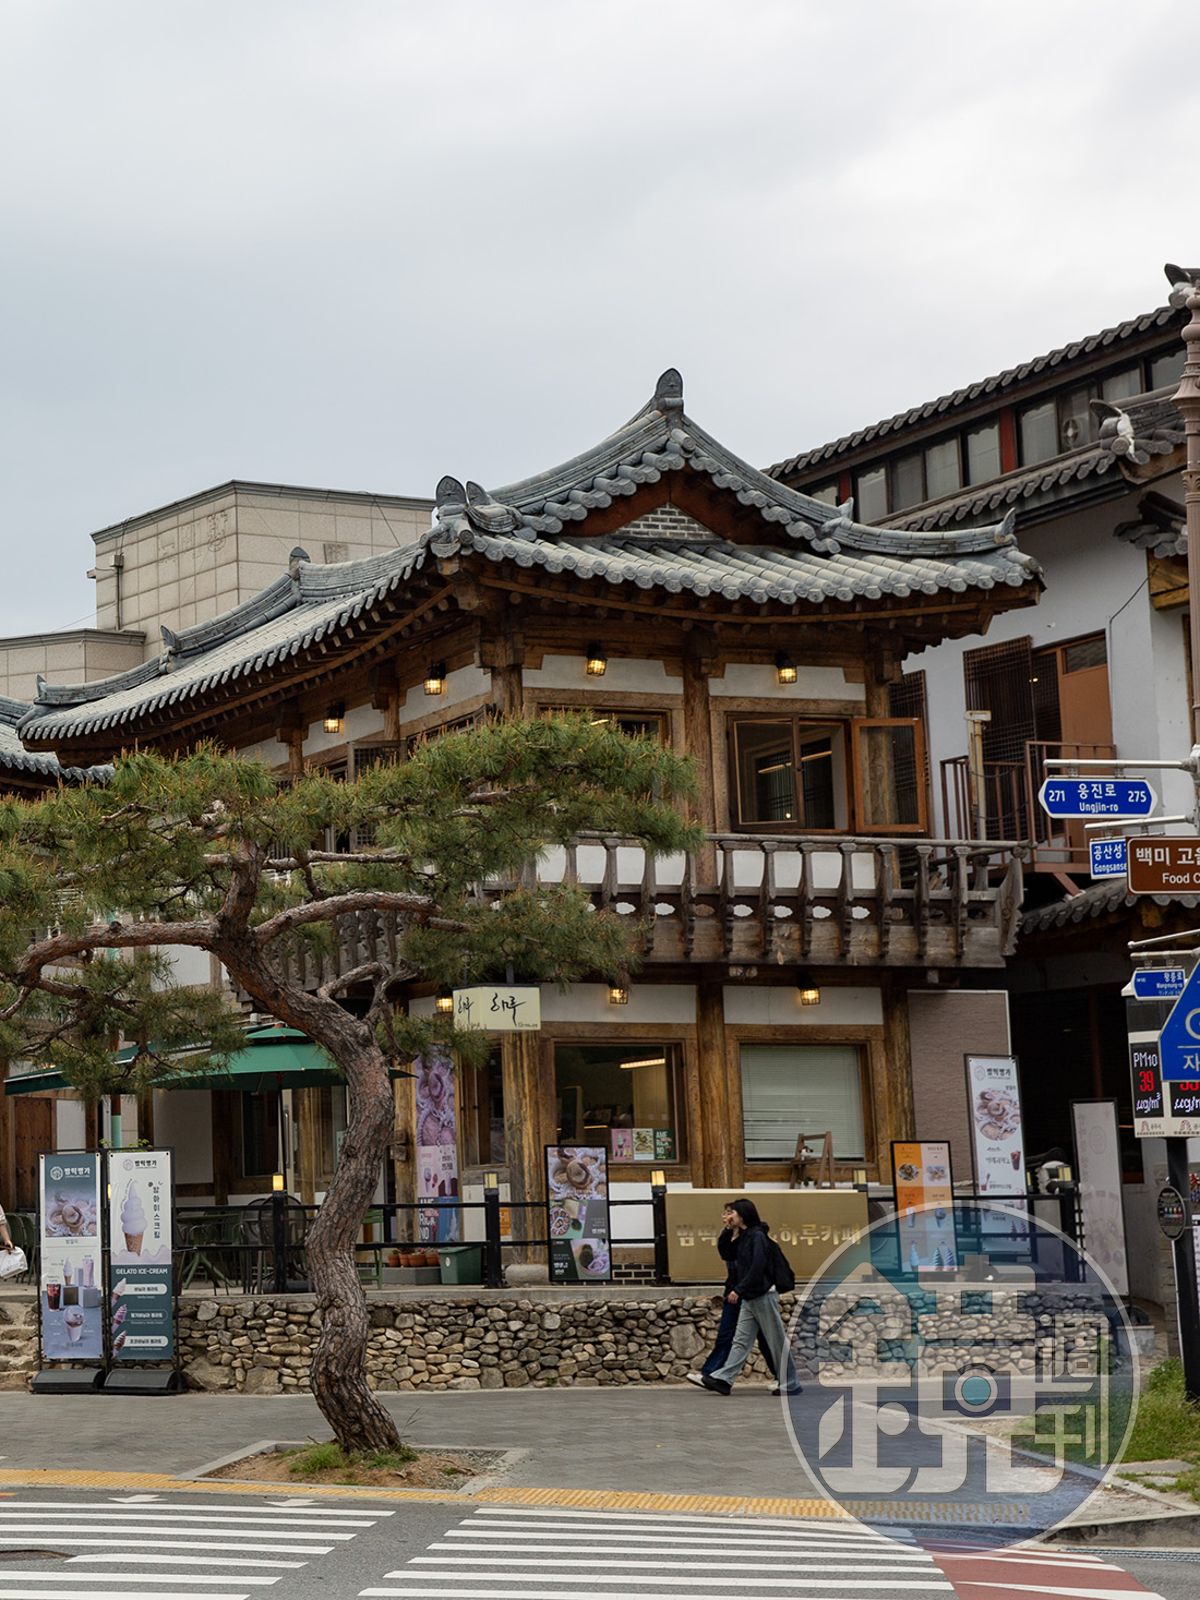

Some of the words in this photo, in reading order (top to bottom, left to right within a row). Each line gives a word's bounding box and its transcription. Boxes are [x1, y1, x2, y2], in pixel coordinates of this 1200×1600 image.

[1048, 790, 1066, 802] 271
[1077, 783, 1117, 799] 웅진로
[1127, 790, 1147, 803] 275
[1079, 802, 1119, 814] Ungjin-ro
[1093, 843, 1127, 861] 공산성
[1135, 846, 1171, 867] 백미
[1162, 872, 1190, 884] Food
[1133, 1052, 1158, 1068] PM10
[1138, 1070, 1155, 1092] 39
[115, 1267, 138, 1275] GELATO
[138, 1267, 168, 1275] ICE-CREAM
